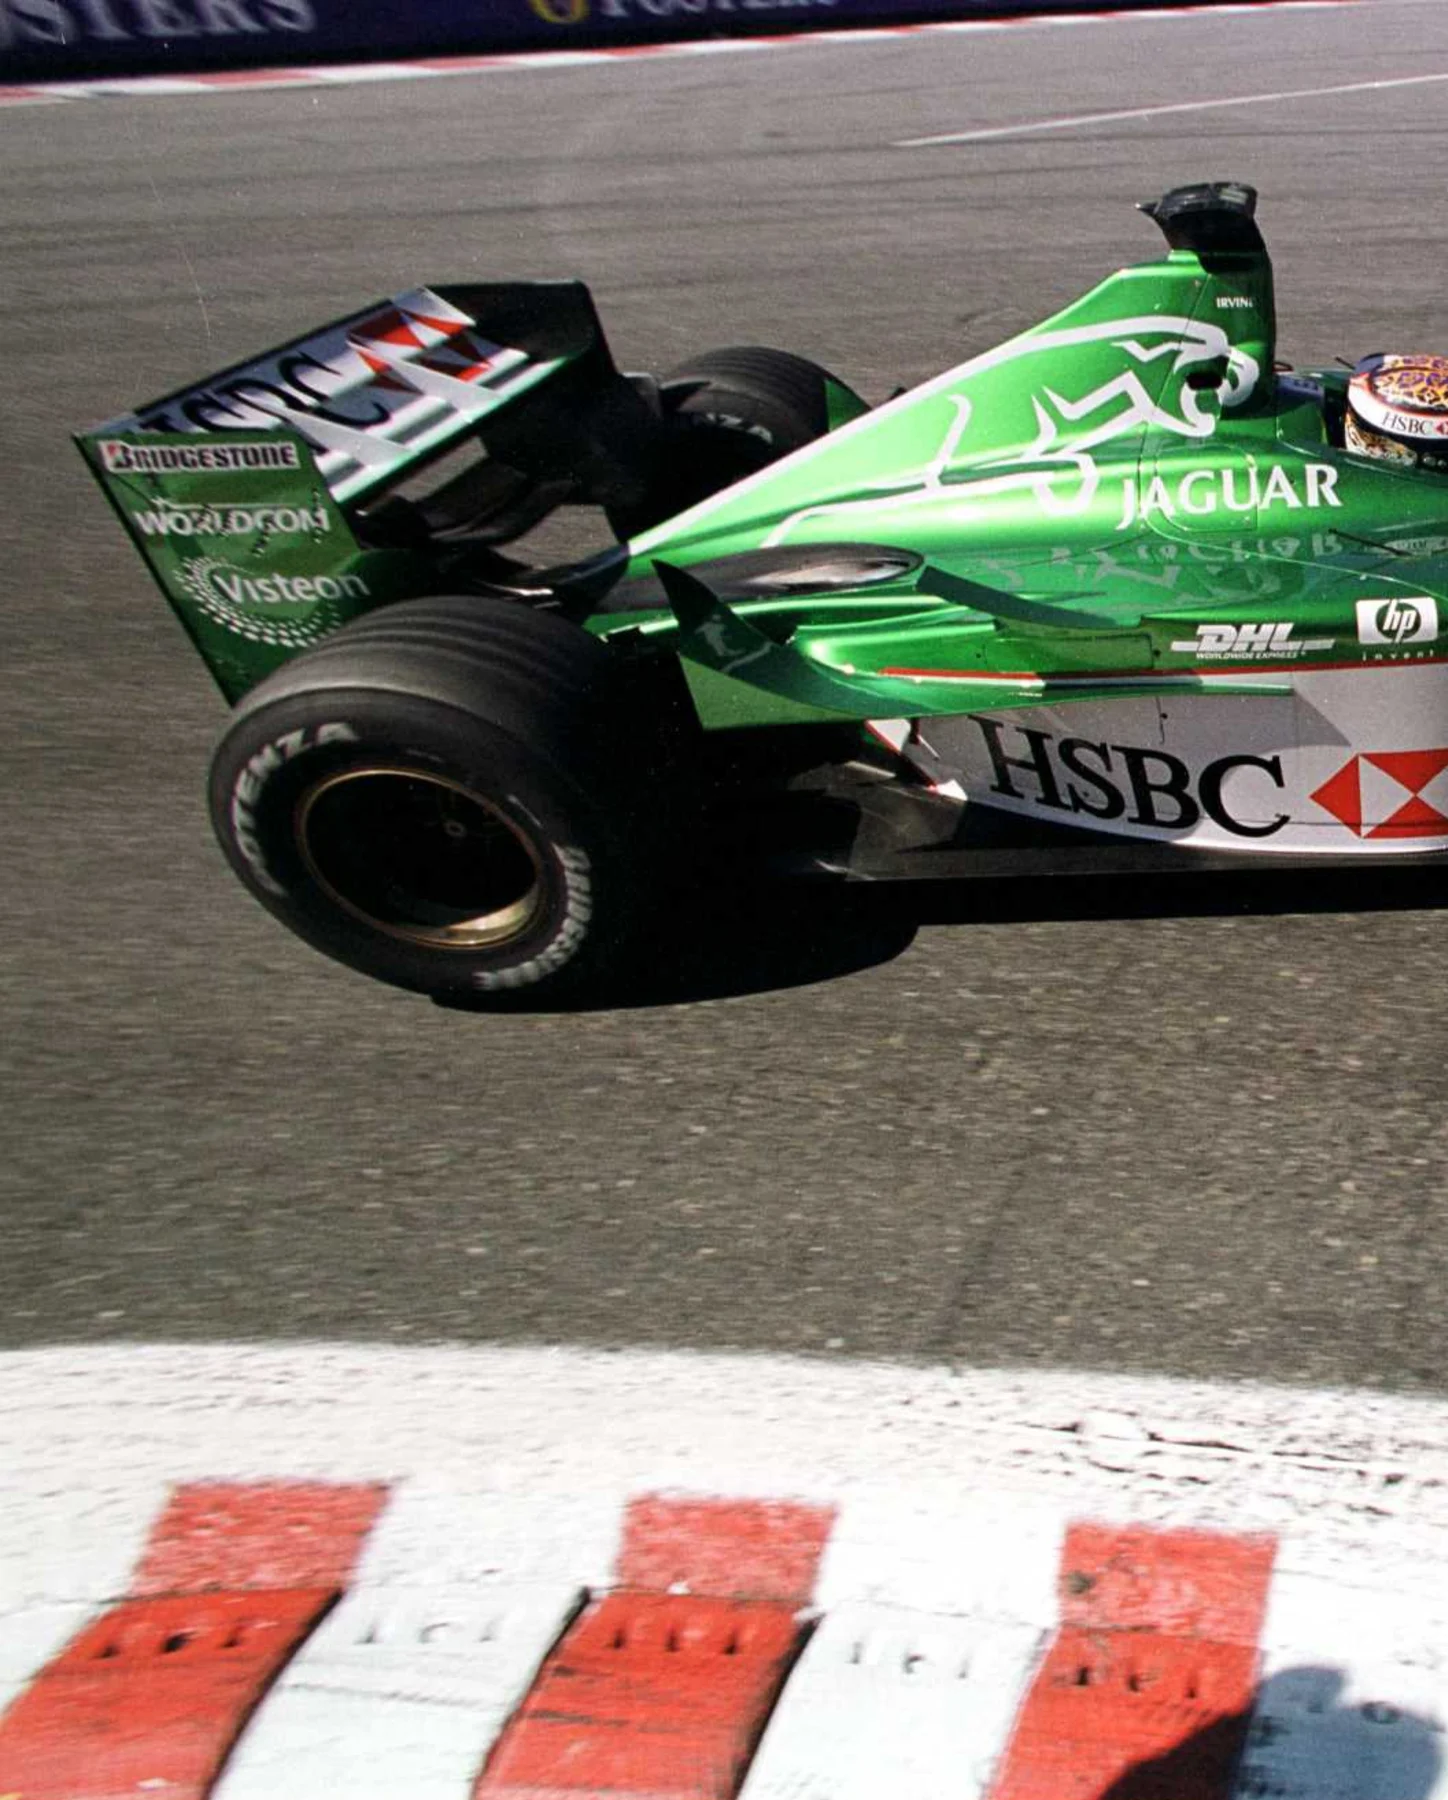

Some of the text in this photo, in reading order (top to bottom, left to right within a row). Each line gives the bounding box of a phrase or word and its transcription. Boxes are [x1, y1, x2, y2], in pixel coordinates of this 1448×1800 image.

[1382, 411, 1433, 435] HSBC
[109, 442, 298, 469] BRIDGESTONE
[1115, 464, 1342, 531] JAGUAR
[134, 508, 330, 536] WORLDCOM
[212, 572, 371, 603] Visteon
[1382, 599, 1417, 643] hp
[1196, 622, 1301, 652] DHL
[1362, 649, 1434, 662] invent
[968, 714, 1292, 838] HSBC
